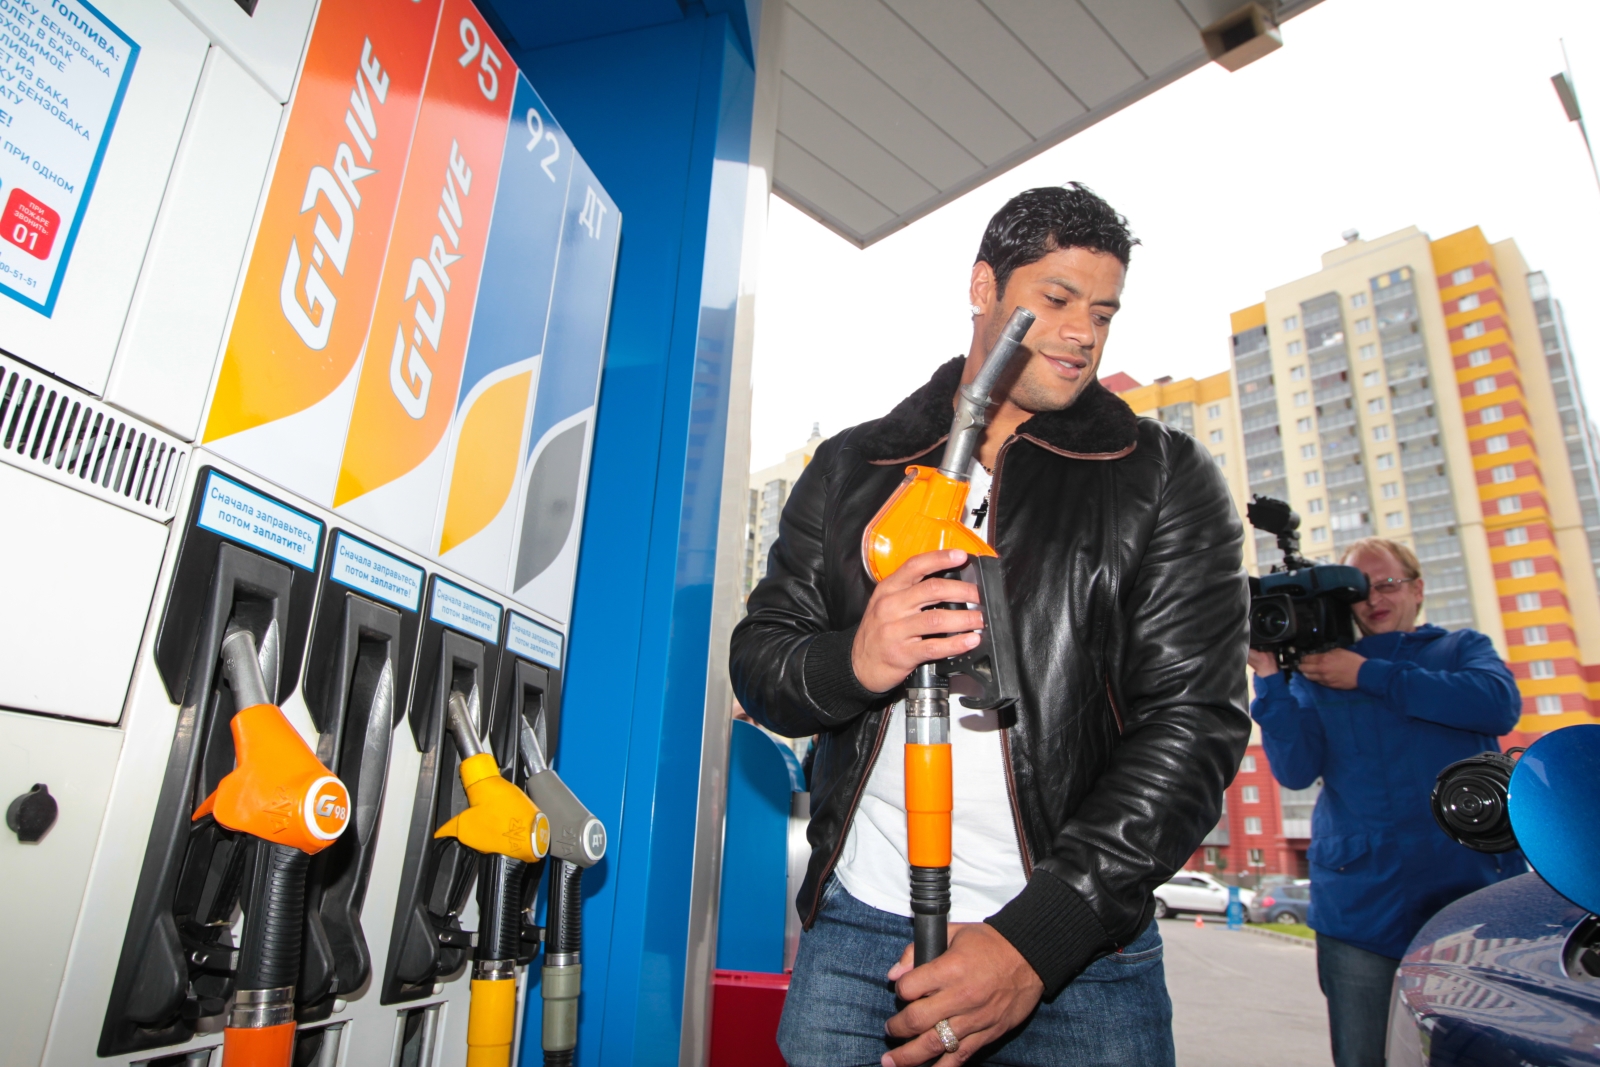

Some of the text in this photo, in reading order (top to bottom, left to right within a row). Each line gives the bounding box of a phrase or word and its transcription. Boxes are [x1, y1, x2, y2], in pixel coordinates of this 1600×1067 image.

[0, 0, 74, 63] ОЛЕТ В БАК
[0, 33, 35, 67] ЛИВА
[13, 0, 110, 77] КУ БЕНЗОБАКА
[51, 0, 120, 61] ТОПЛИВА:
[457, 17, 502, 102] 95
[15, 61, 34, 81] ИЗ
[35, 77, 70, 109] БАКА
[16, 80, 90, 141] БЕНЗОБАКА
[3, 141, 75, 194] ПРИ ОДНОМ
[525, 107, 561, 183] 92
[18, 204, 50, 228] ПОЖАРЕ
[28, 202, 45, 215] ПРИ
[578, 185, 607, 240] ДТ
[12, 223, 39, 251] 01
[210, 486, 314, 545] Сначала заправьтесь,
[218, 510, 306, 555] потом заплатите!
[339, 545, 418, 589] Сначала заправьтесь,
[345, 564, 411, 598] потом заплатите!
[436, 588, 462, 607] Сначала
[441, 605, 460, 618] потом
[334, 805, 346, 820] 98
[591, 833, 604, 848] ДТ
